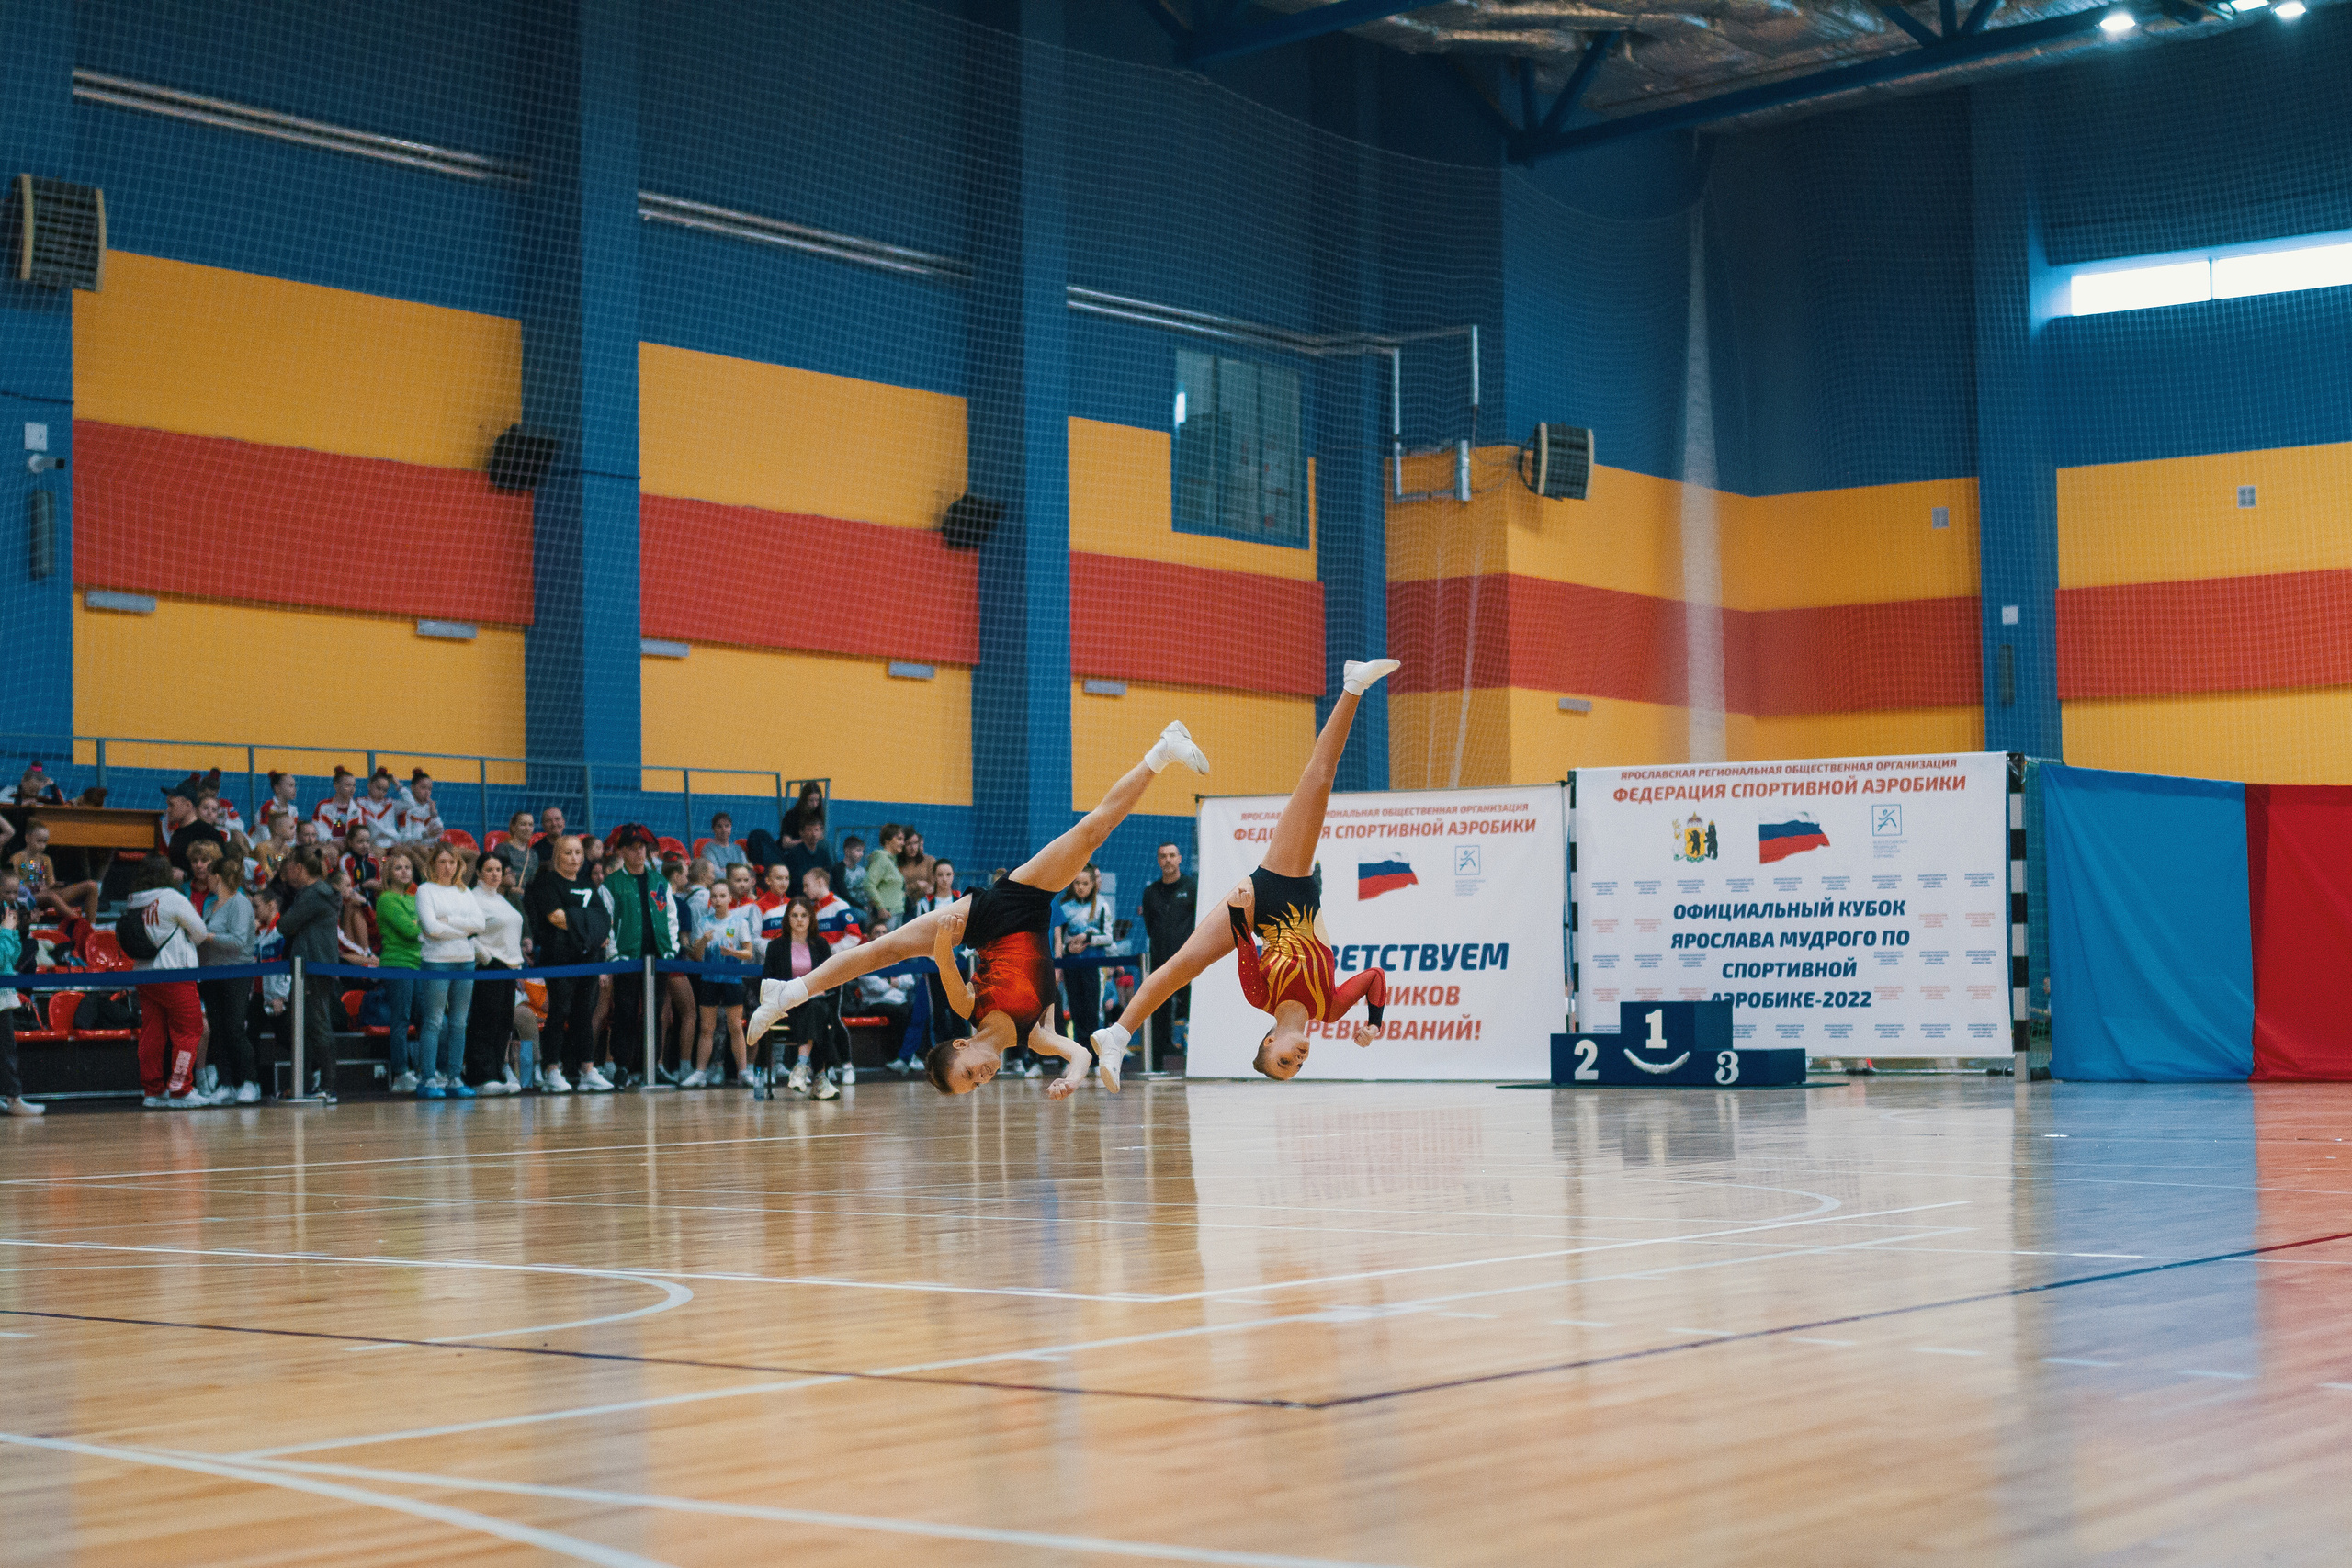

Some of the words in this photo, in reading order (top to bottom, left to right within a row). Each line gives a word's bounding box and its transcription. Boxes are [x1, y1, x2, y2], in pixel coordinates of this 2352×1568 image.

[1621, 768, 1695, 780] ЯРОСЛАВСКАЯ
[1699, 765, 1782, 778] РЕГИОНАЛЬНАЯ
[1785, 761, 1873, 774] ОБЩЕСТВЕННАЯ
[1876, 759, 1958, 772] ОРГАНИЗАЦИЯ
[1613, 784, 1726, 804] ФЕДЕРАЦИЯ
[1731, 775, 1858, 798] СПОРТИВНОЙ
[1861, 775, 1966, 795] АЭРОБИКИ
[1382, 806, 1458, 818] ОБЩЕСТВЕННАЯ
[1460, 803, 1529, 815] ОРГАНИЗАЦИЯ
[1335, 818, 1443, 840] СПОРТИВНОЙ
[1447, 818, 1537, 836] АЭРОБИКИ
[1673, 897, 1834, 921] ОФИЦИАЛЬНЫЙ
[1838, 899, 1906, 917] КУБОК
[1670, 931, 1775, 949] ЯРОСЛАВА
[1780, 931, 1877, 951] МУДРОГО
[1881, 930, 1910, 946] ПО
[1722, 957, 1857, 978] СПОРТИВНОЙ
[1645, 1009, 1668, 1049] 1
[1574, 1039, 1599, 1080] 2
[1714, 1051, 1739, 1085] 3
